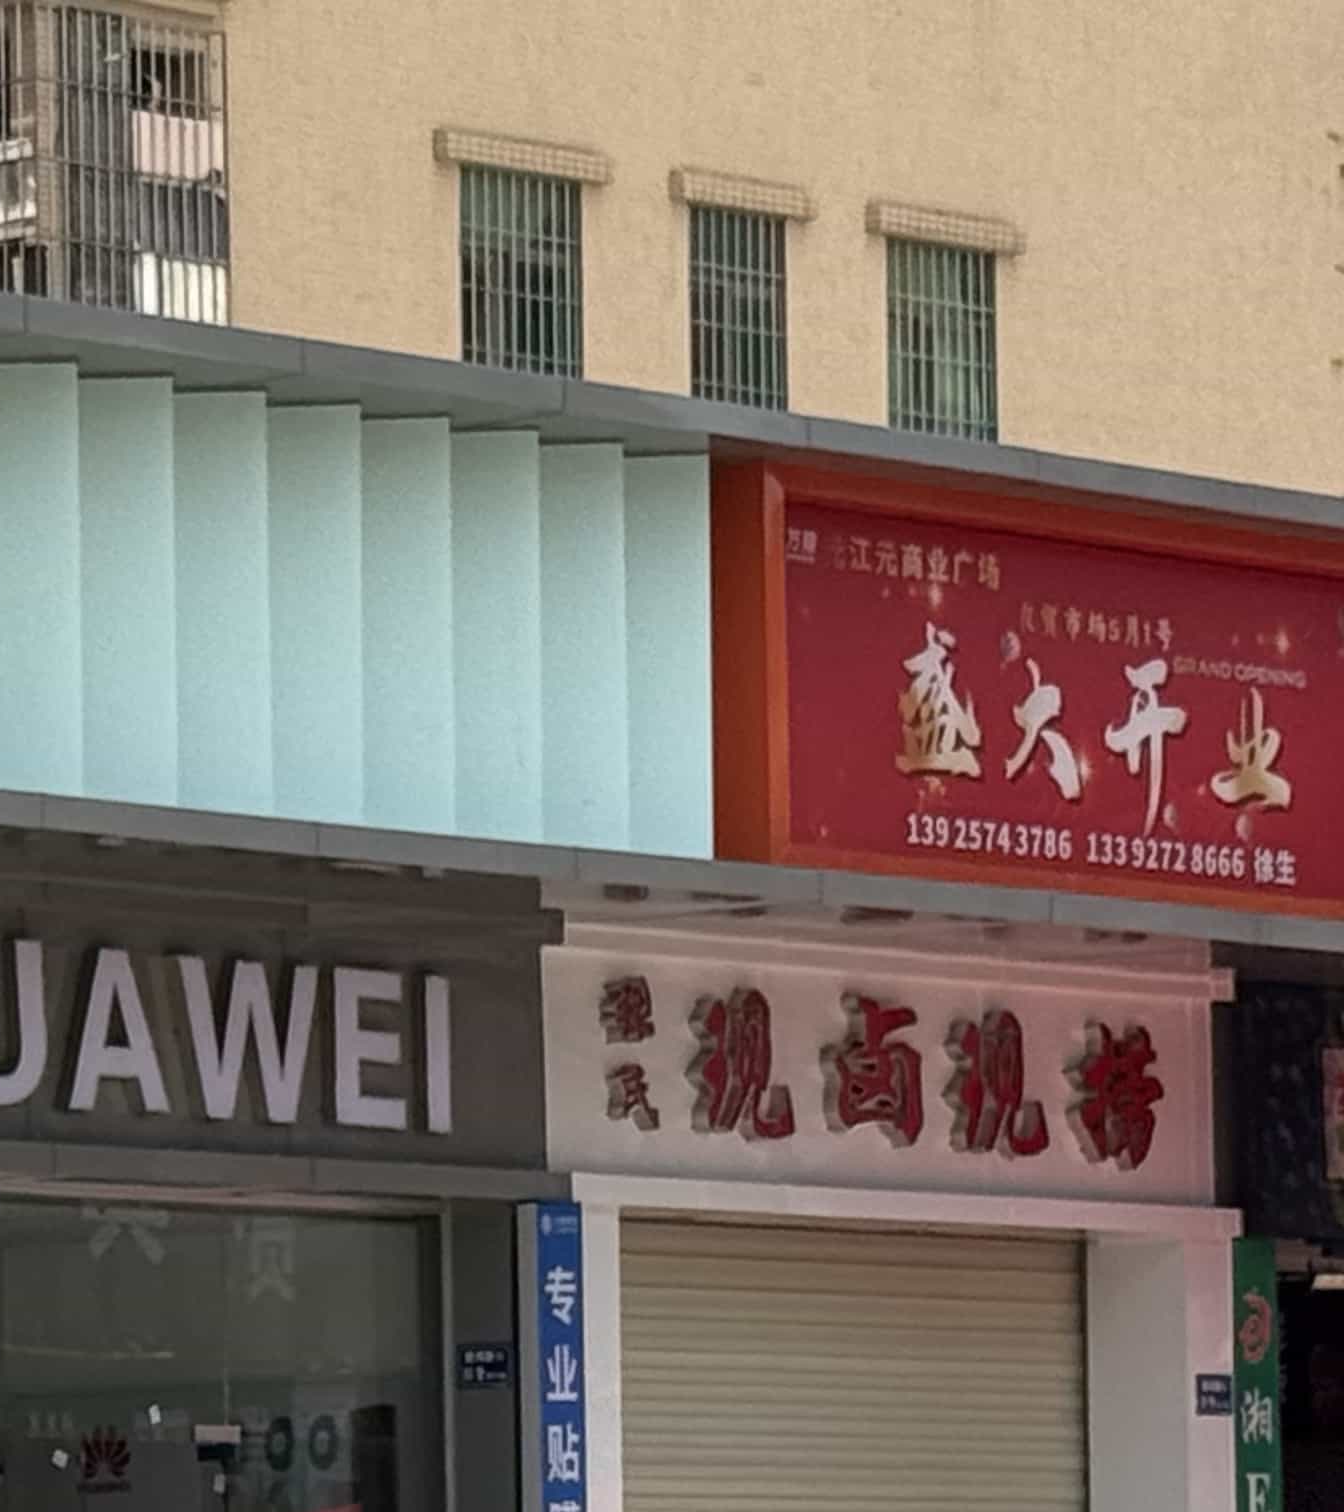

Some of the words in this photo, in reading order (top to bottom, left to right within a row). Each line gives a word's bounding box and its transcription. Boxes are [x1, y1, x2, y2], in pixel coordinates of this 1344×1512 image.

[835, 536, 1000, 591] 江元商业广场
[1234, 663, 1307, 689] OPENING
[896, 622, 1292, 838] 盛大开业
[906, 815, 1072, 860] 13925743786
[1086, 831, 1246, 878] 13392728666
[1253, 847, 1297, 886] 徐生
